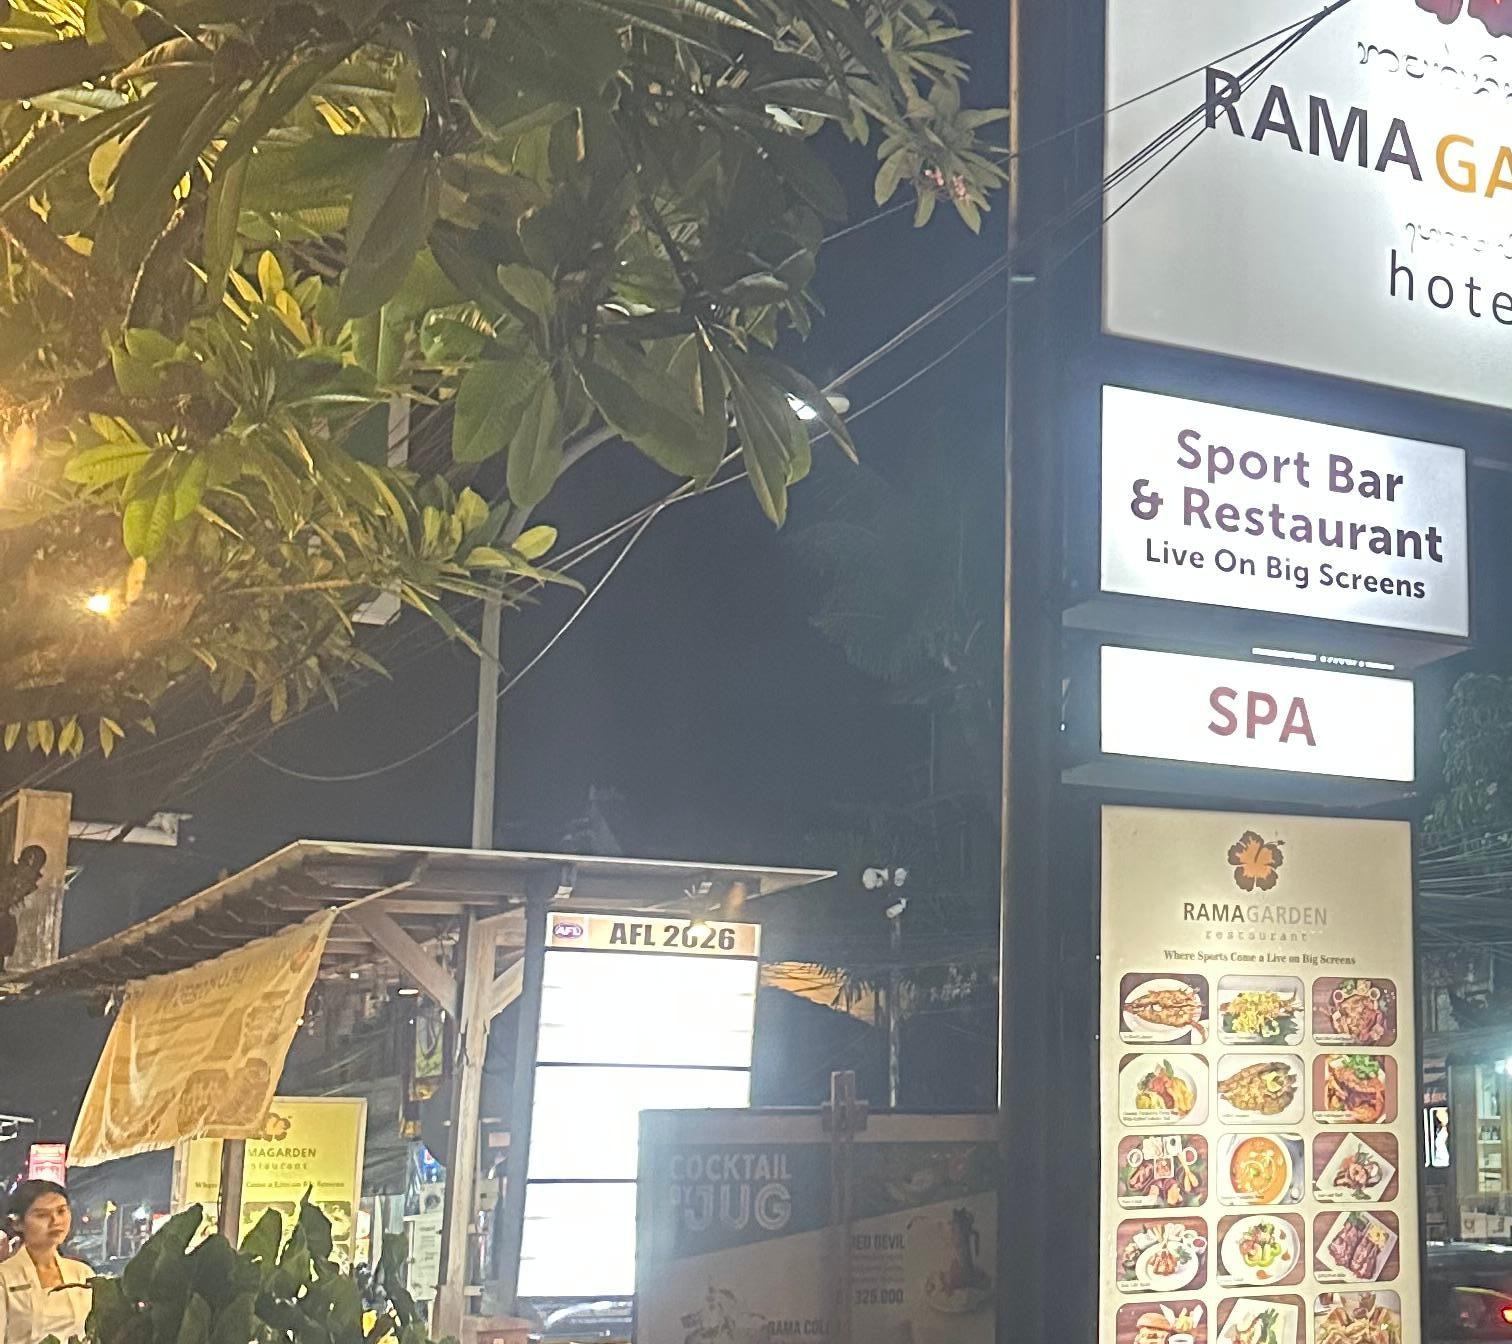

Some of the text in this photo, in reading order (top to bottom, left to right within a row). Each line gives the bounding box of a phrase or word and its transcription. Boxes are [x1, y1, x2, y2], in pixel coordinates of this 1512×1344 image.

[1177, 429, 1404, 502] Sport Bar
[1131, 478, 1443, 563] & Restaurant
[1146, 537, 1426, 599] Live On Big Screens
[1207, 686, 1316, 747] SPA
[609, 922, 736, 951] AFL 2026
[1198, 951, 1228, 963] Sports
[1266, 952, 1287, 964] Live
[1302, 953, 1319, 966] Big
[1319, 955, 1357, 966] Screens
[670, 1153, 793, 1181] COCKTAIL
[684, 1183, 792, 1231] JUG
